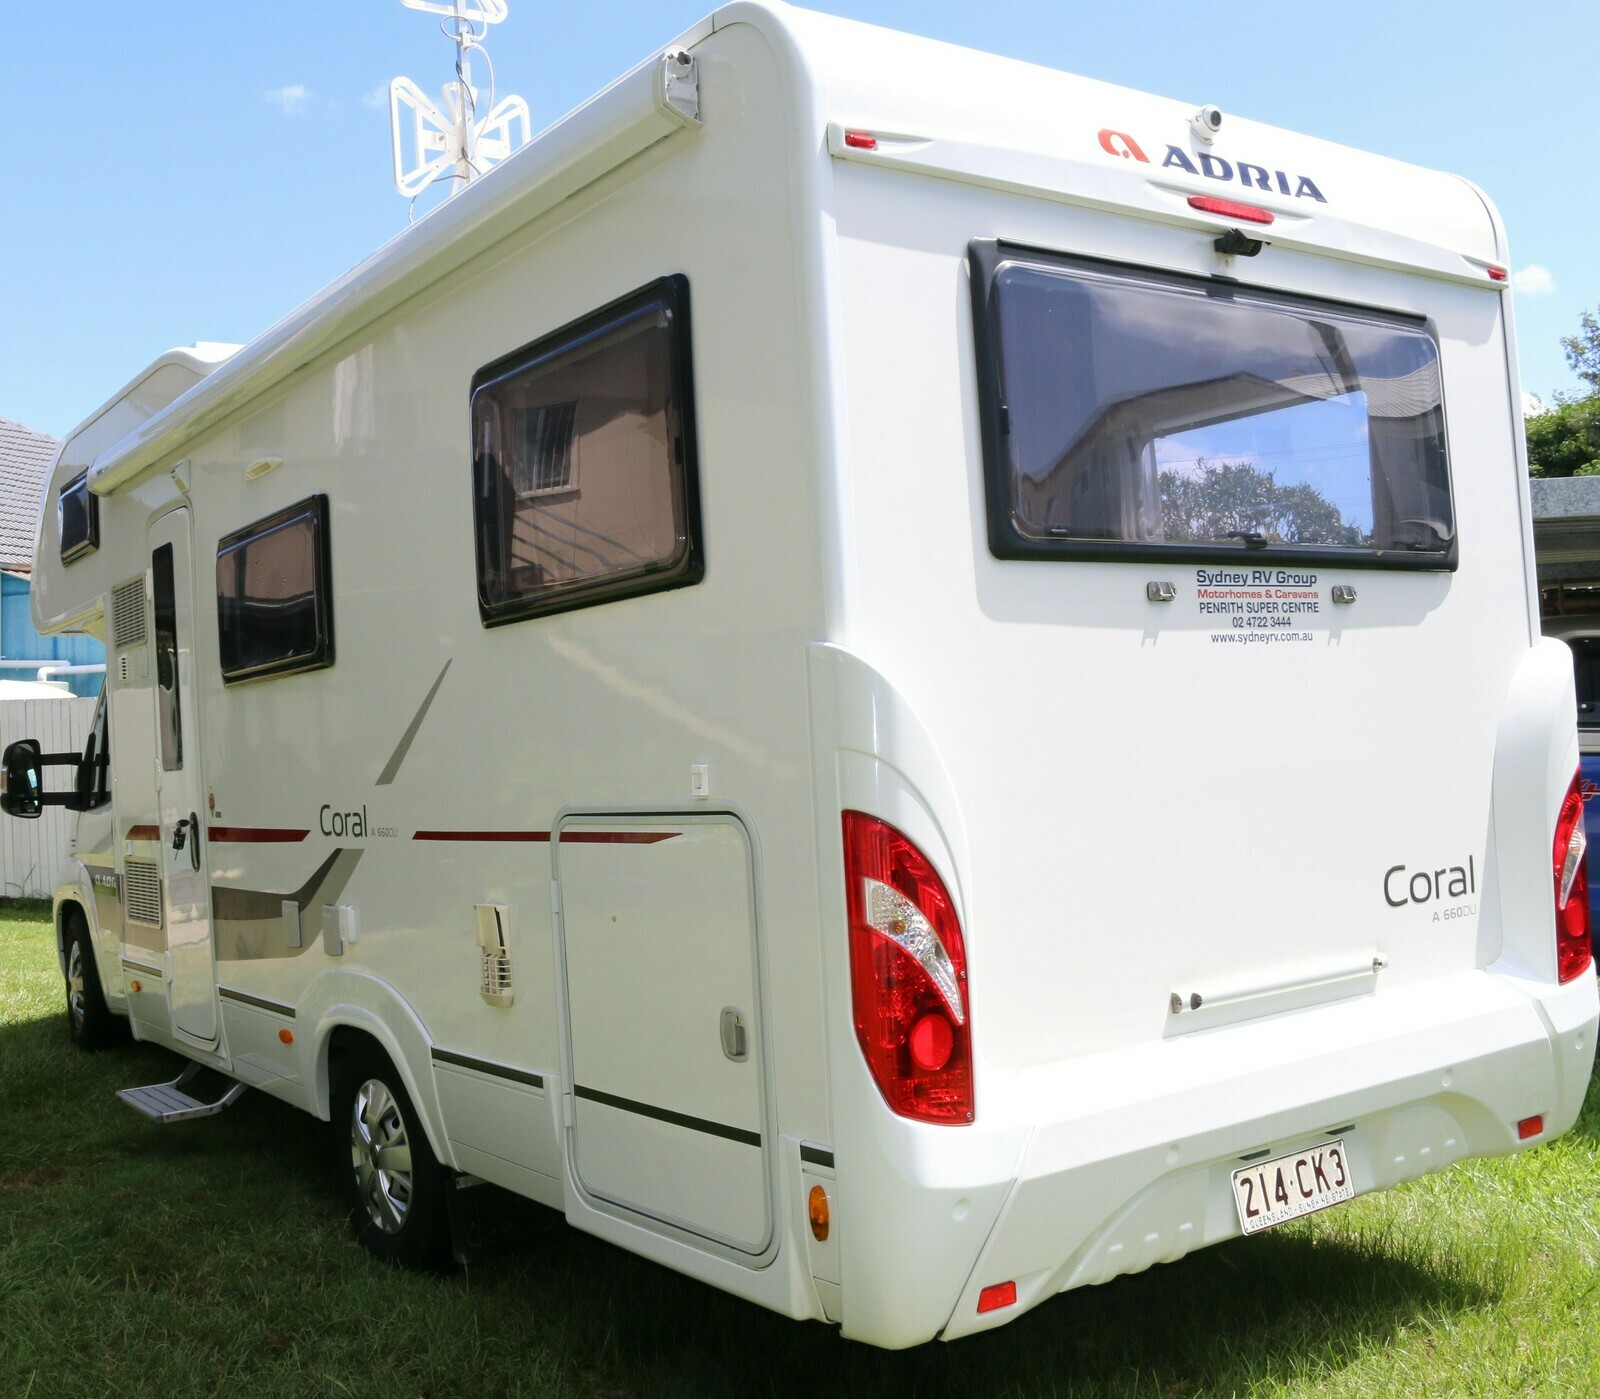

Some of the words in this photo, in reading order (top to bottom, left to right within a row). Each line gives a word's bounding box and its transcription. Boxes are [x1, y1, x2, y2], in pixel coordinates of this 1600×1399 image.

[1162, 144, 1328, 203] ADRIA
[1196, 569, 1249, 587] Sydney
[1252, 571, 1273, 584] RV
[1276, 571, 1318, 587] Group
[1197, 589, 1263, 599] Motorhomes
[1265, 589, 1273, 599] &
[1274, 589, 1319, 599] Caravans
[1199, 602, 1243, 614] PENRITH
[1246, 602, 1280, 614] SUPER
[1282, 602, 1320, 613] CENTRE
[1232, 617, 1244, 628] 02
[1246, 617, 1268, 628] 4722
[1270, 616, 1292, 627] 3444
[1211, 631, 1313, 644] www.sydneyrv.com.au
[320, 803, 368, 837] Coral
[1383, 854, 1475, 907] Coral
[1432, 911, 1441, 923] A
[1443, 904, 1477, 921] 660DU
[1249, 1207, 1292, 1229] QUEENSLAND
[1331, 1187, 1350, 1202] STATE
